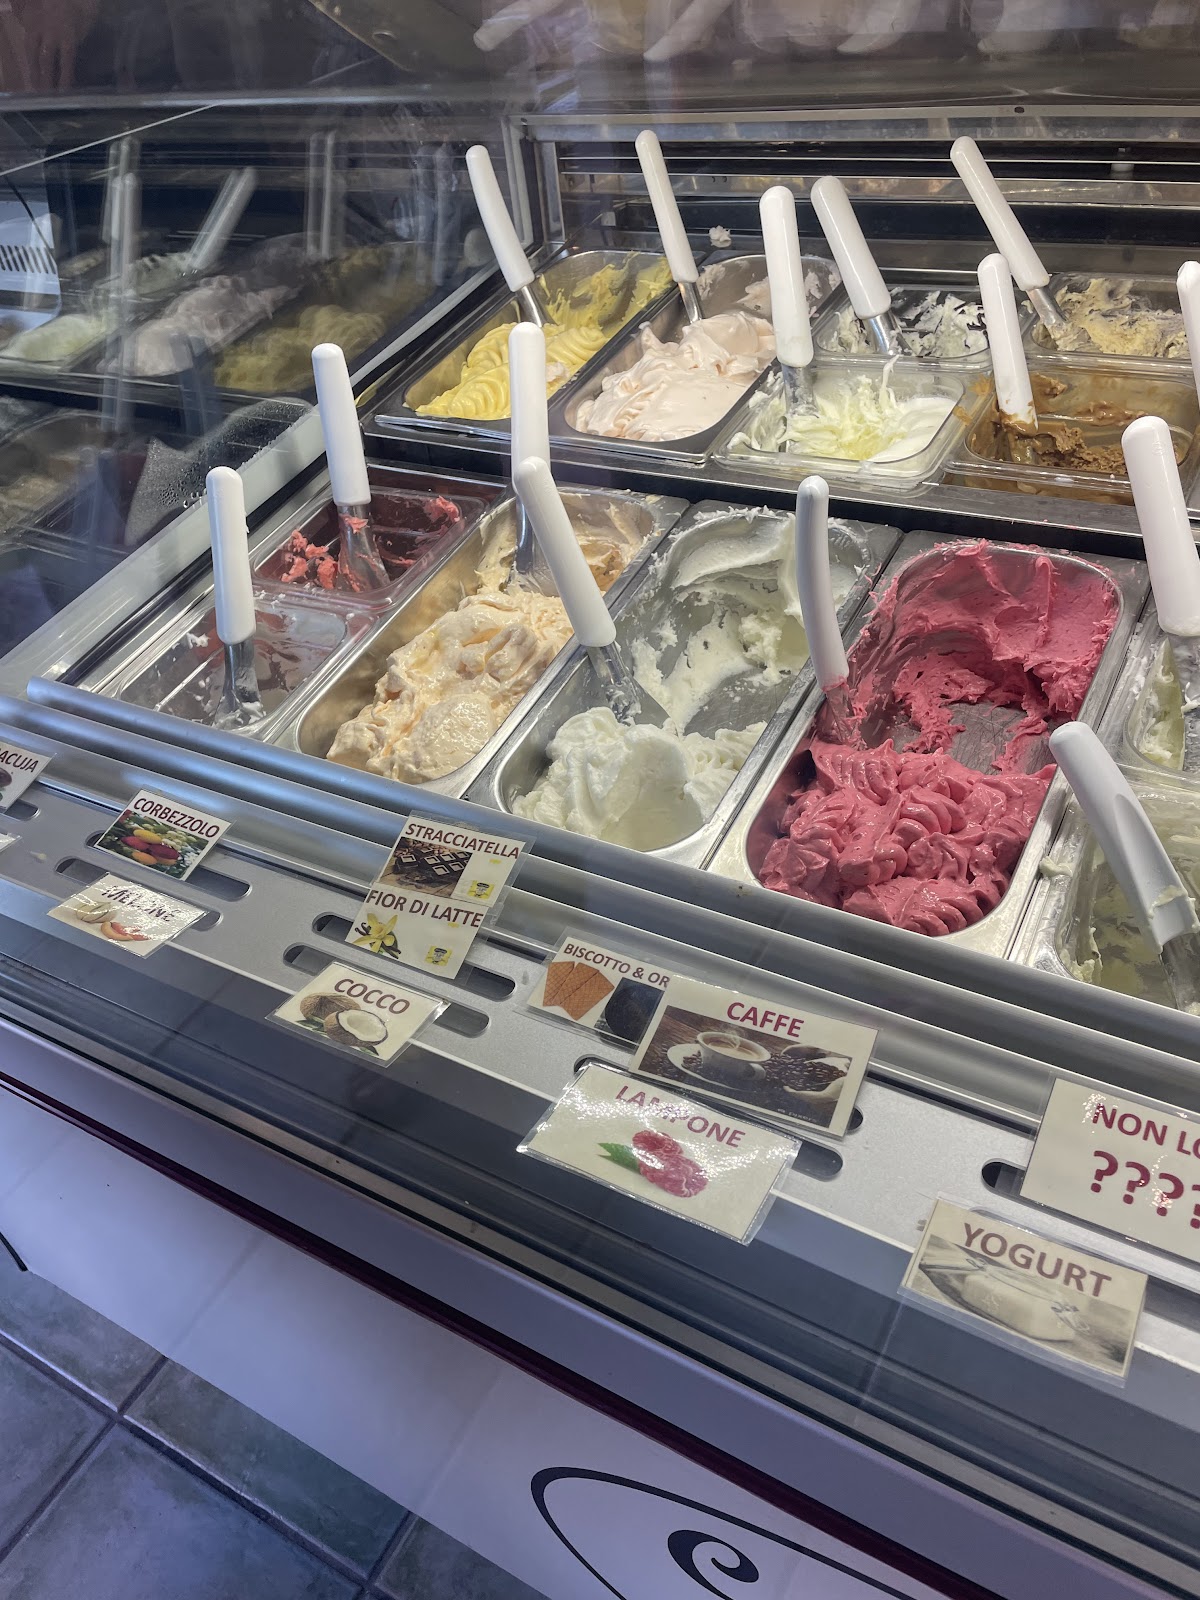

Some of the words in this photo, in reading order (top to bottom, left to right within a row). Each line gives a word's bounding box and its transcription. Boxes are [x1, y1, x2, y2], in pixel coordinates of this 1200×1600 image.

[0, 748, 39, 773] ACUJA
[133, 797, 221, 839] CORBEZZOLO
[405, 823, 520, 859] STRACCIATELLA
[366, 890, 408, 912] FIOR
[409, 899, 430, 916] DI
[431, 904, 484, 928] LATTE
[563, 943, 631, 974] BISCOTTO
[632, 967, 645, 979] &
[334, 978, 410, 1015] COCCO
[726, 1001, 804, 1038] CAFFE
[1092, 1103, 1168, 1146] NON
[963, 1222, 1113, 1297] YOGURT
